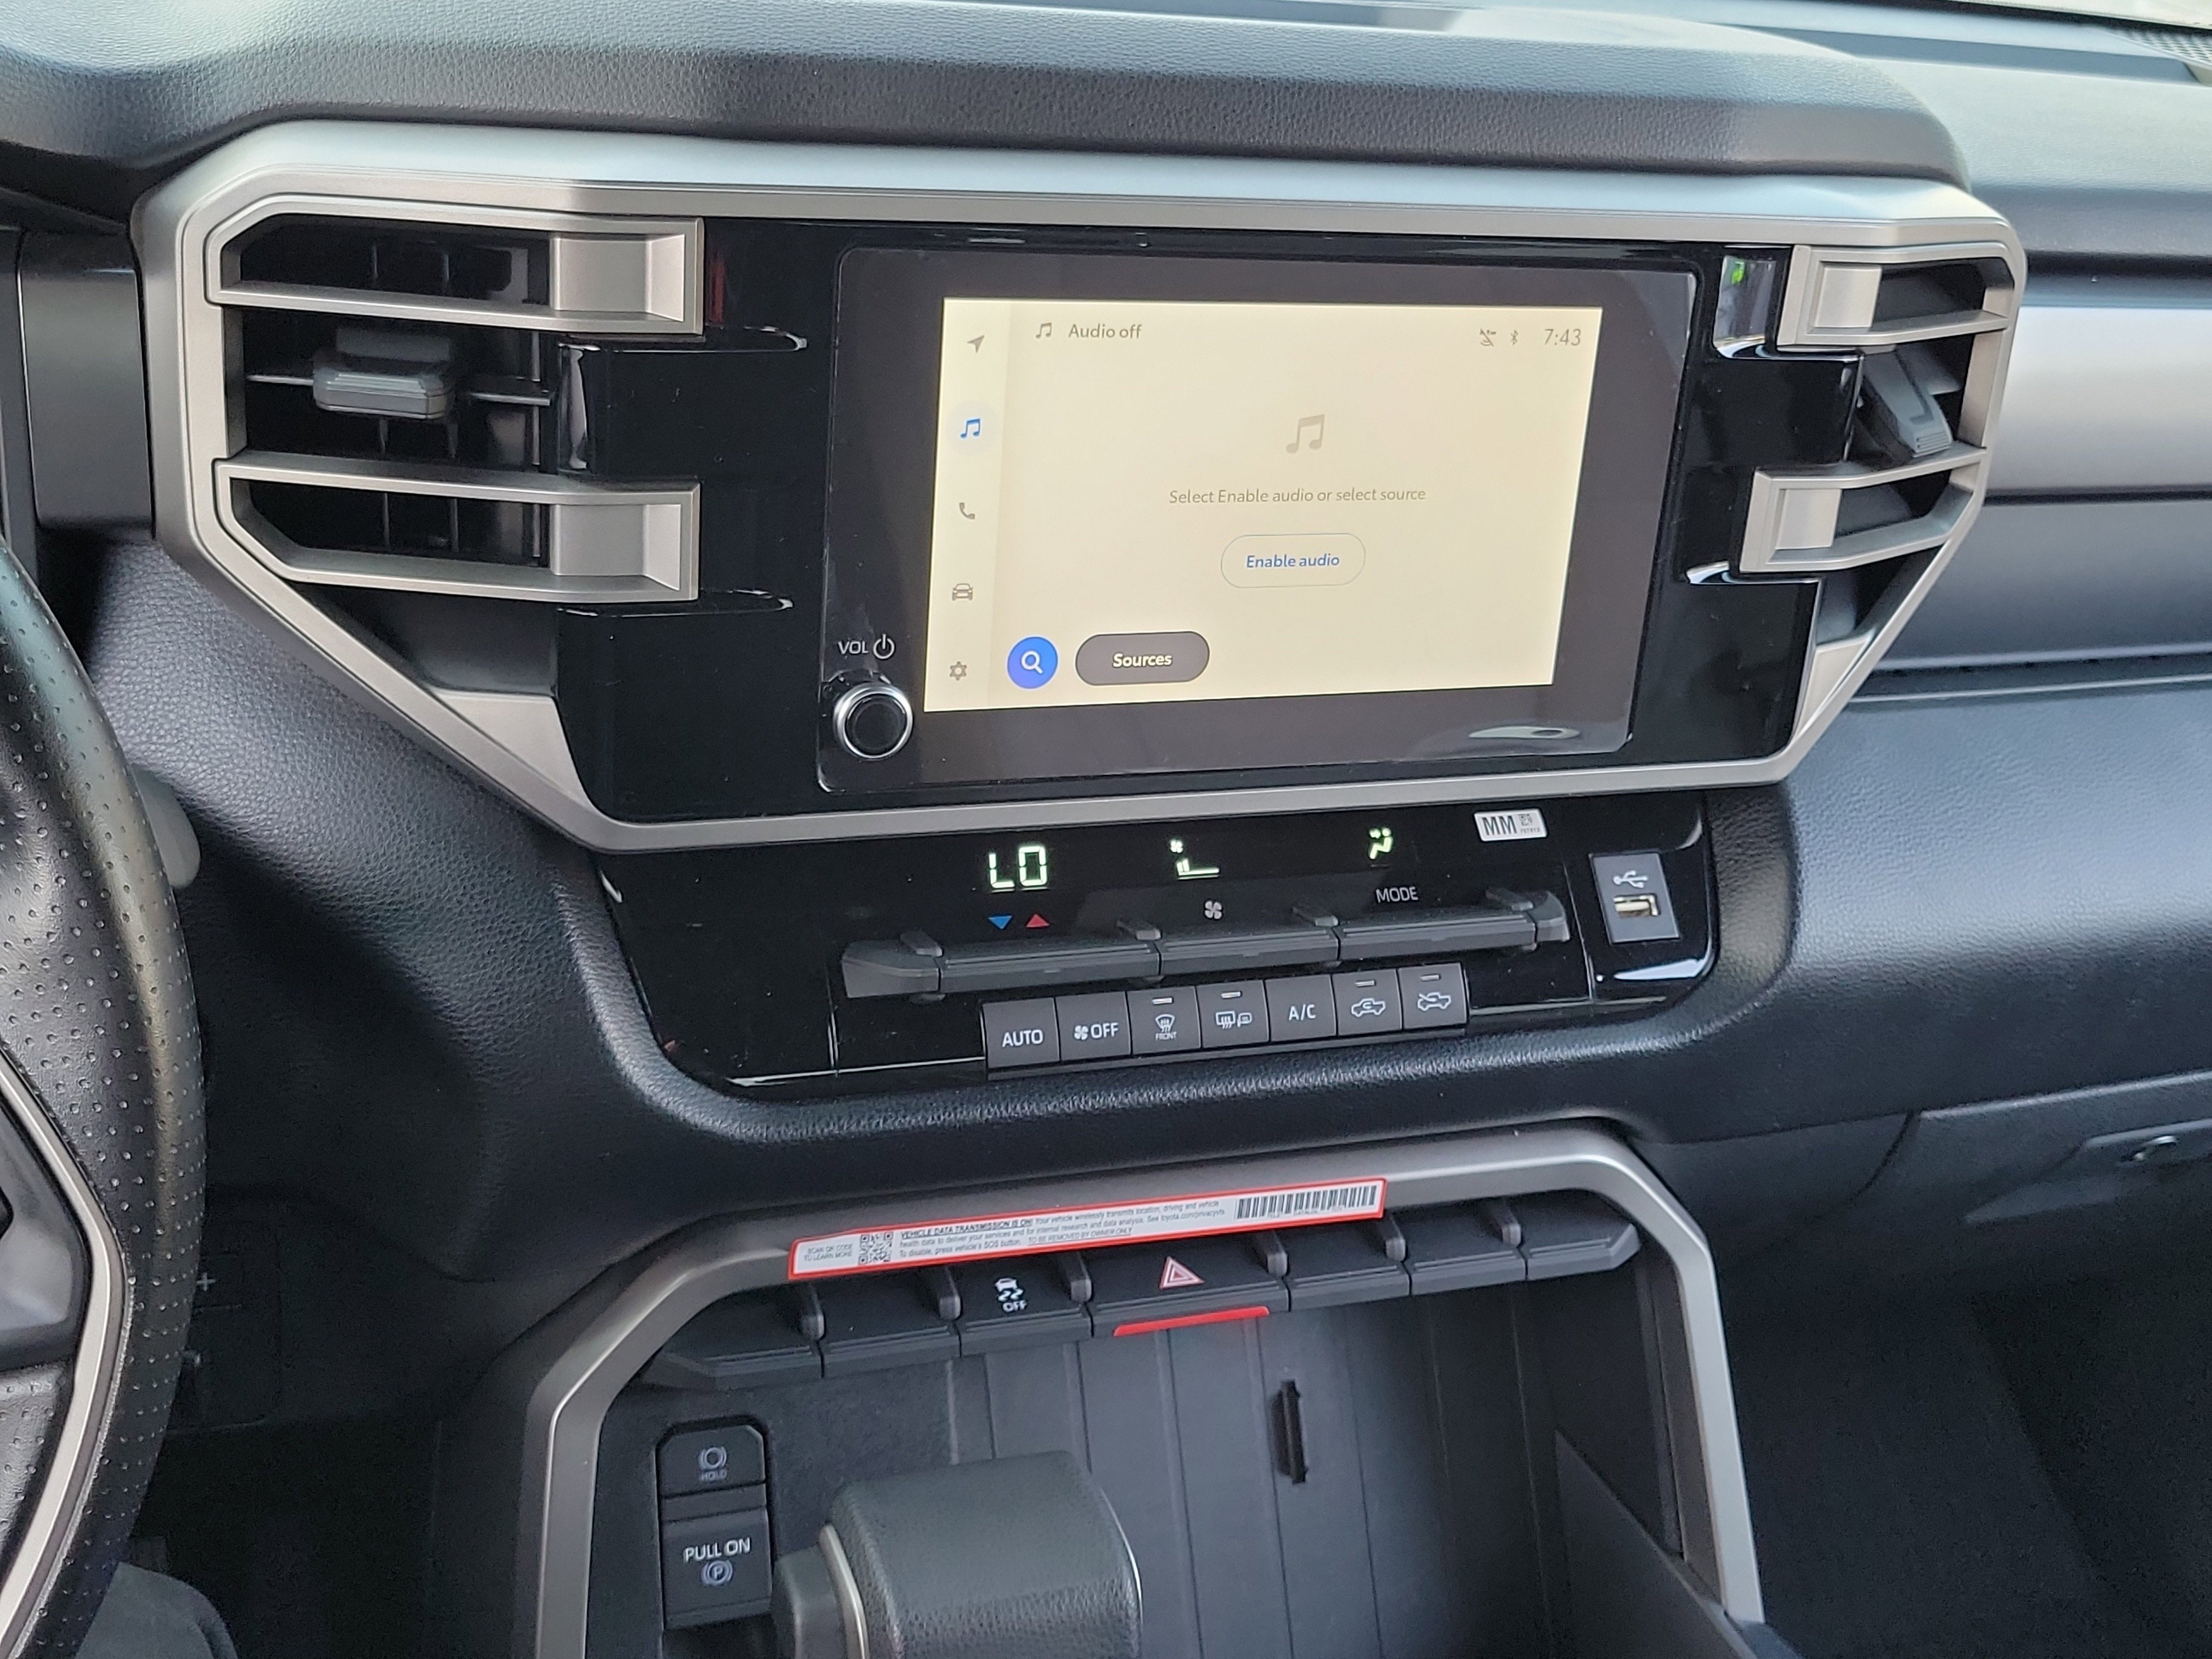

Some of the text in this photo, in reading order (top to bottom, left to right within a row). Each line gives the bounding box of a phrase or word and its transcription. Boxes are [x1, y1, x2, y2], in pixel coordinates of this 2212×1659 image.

[1068, 324, 1143, 338] Audio off
[1545, 329, 1582, 346] 7:43
[1169, 487, 1426, 504] Select Enable audio or select source
[1246, 553, 1340, 568] Enable audio
[838, 641, 868, 654] VOL
[1113, 653, 1172, 667] Sources
[1481, 815, 1517, 836] MM
[1375, 886, 1418, 903] MODE
[1288, 1004, 1317, 1021] A/C
[1002, 1029, 1043, 1047] AUTO
[1090, 1022, 1119, 1039] OFF
[1155, 1031, 1177, 1041] FRONT
[901, 1229, 932, 1238] VEHICLE
[935, 1227, 953, 1235] DATA
[956, 1220, 1009, 1233] TRANSMISSION
[1012, 1219, 1019, 1227] IS
[1003, 1300, 1028, 1312] OFF
[700, 1469, 727, 1481] HOLD
[684, 1537, 751, 1562] PULL ON
